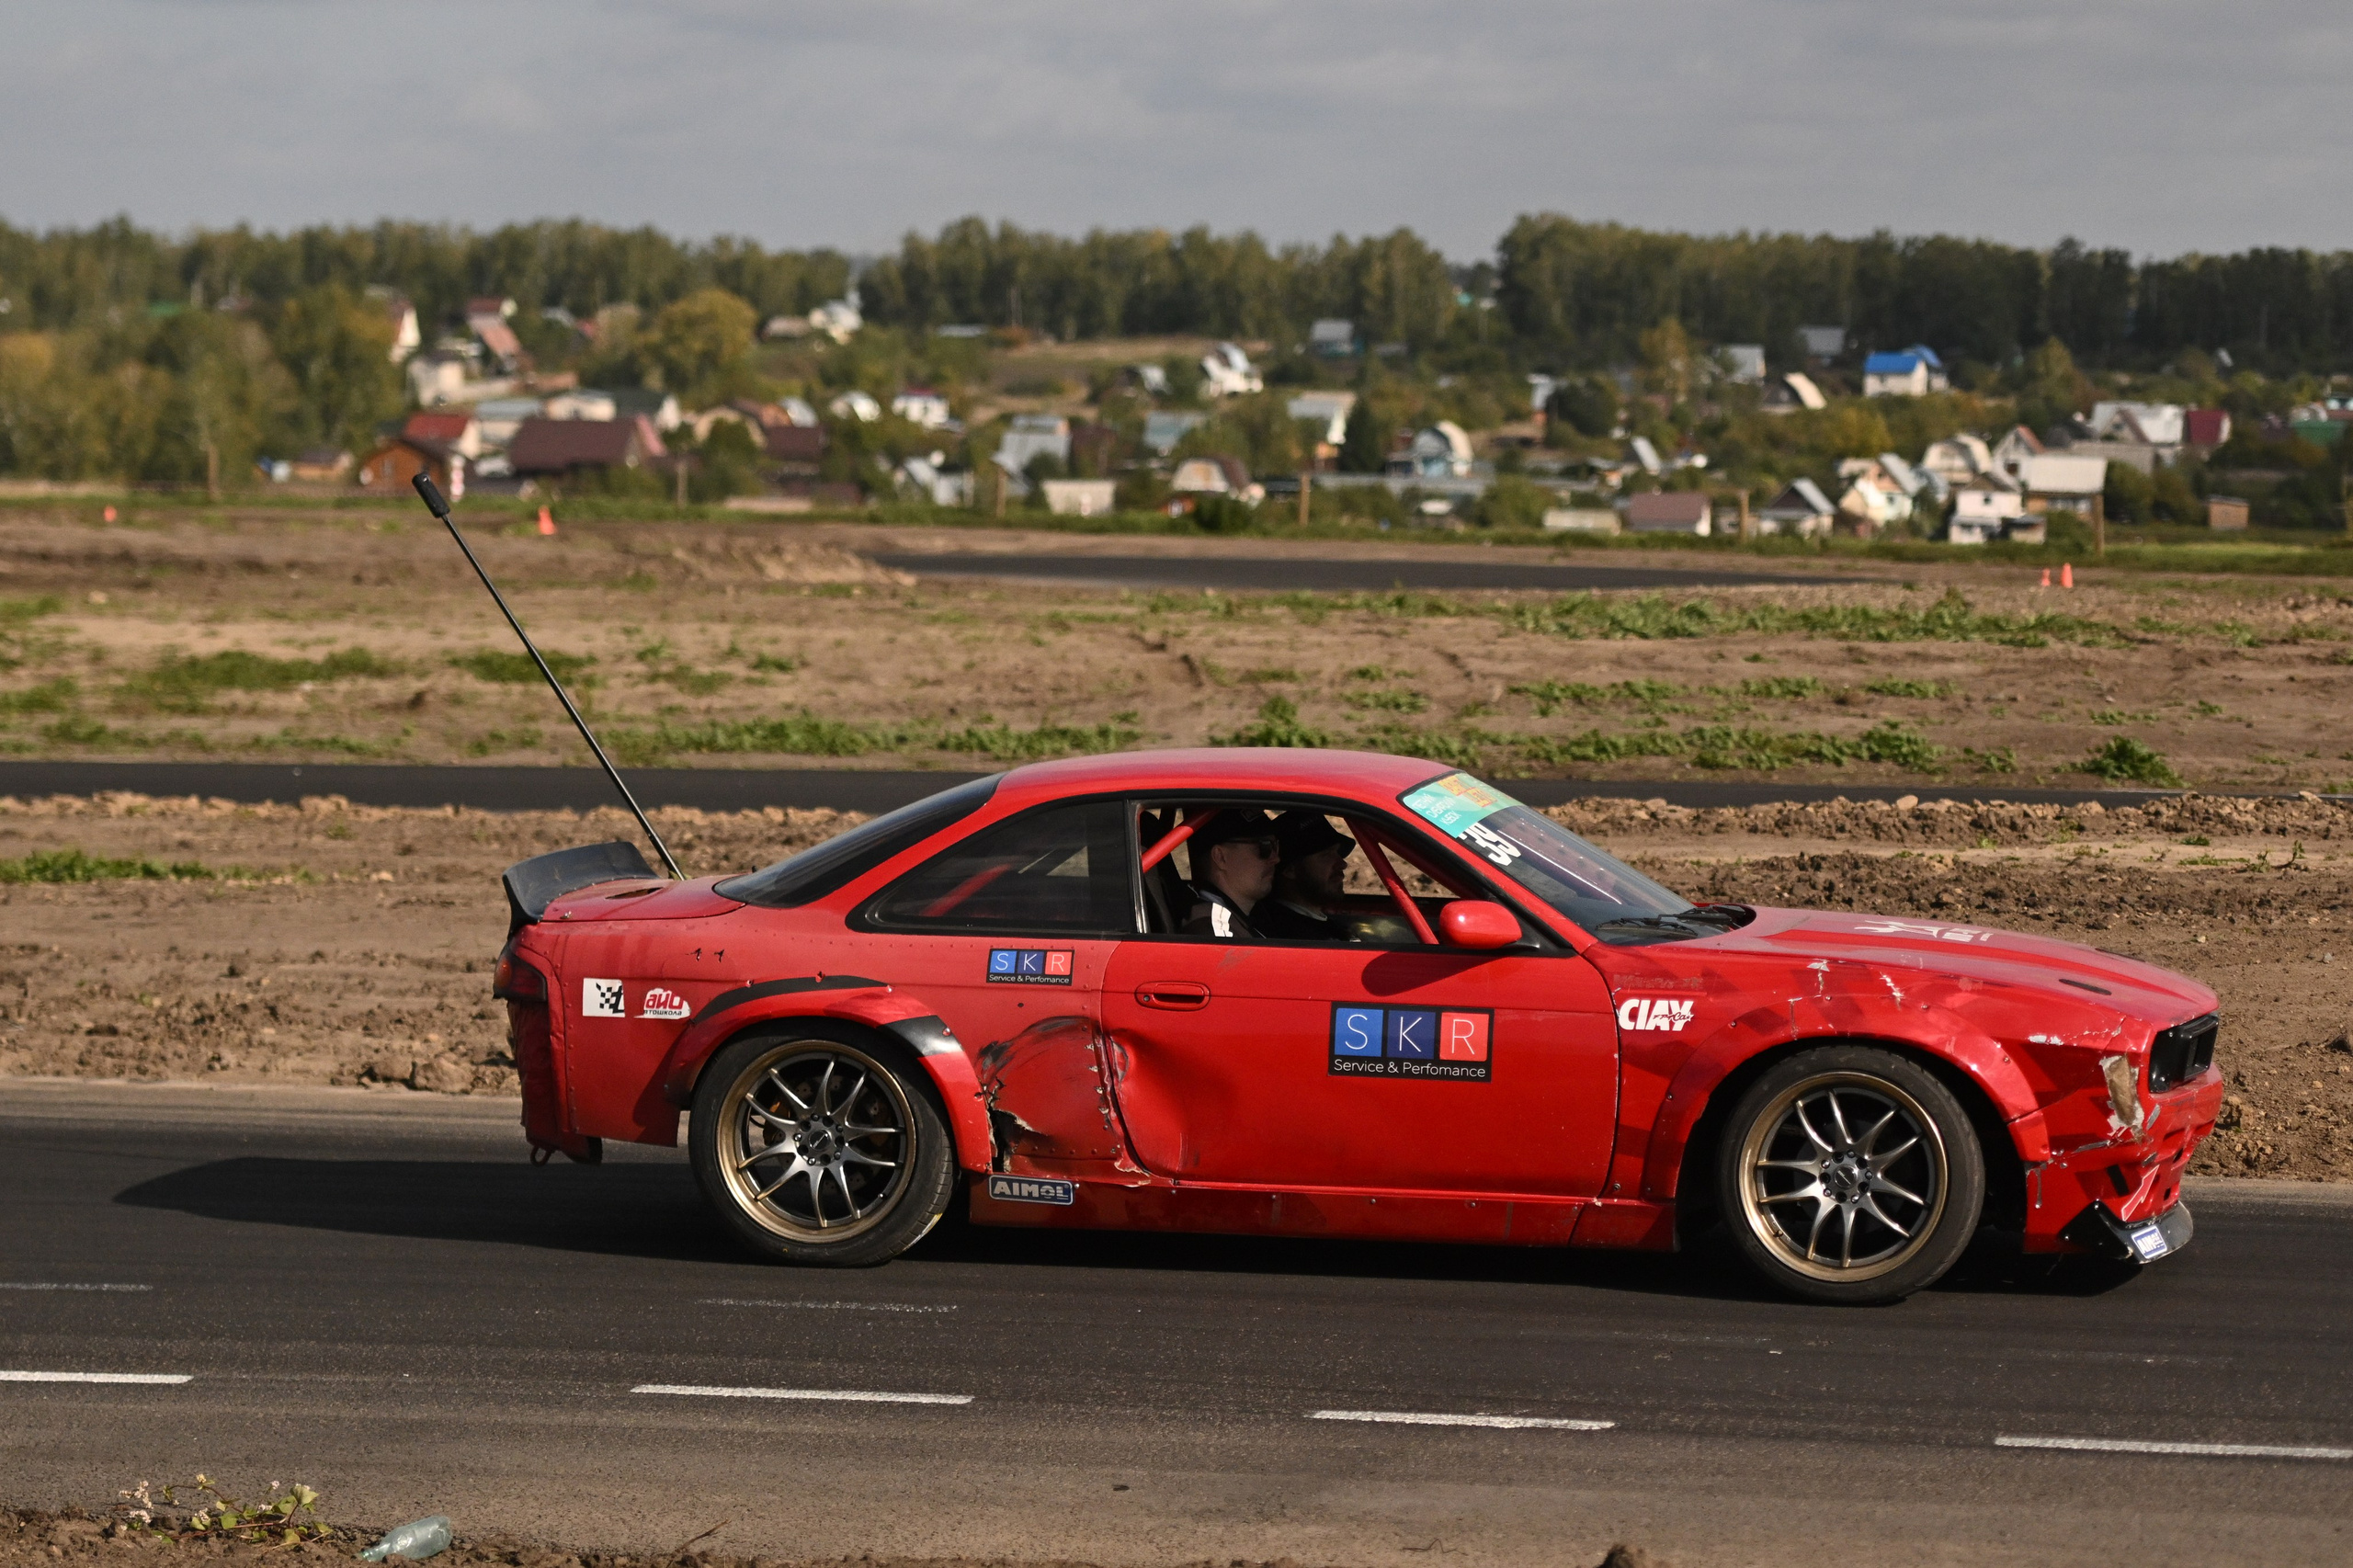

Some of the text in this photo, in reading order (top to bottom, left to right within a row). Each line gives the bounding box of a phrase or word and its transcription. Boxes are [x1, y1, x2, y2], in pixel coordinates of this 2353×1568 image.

[995, 952, 1064, 972] SKR
[989, 974, 1016, 983] Service
[1025, 975, 1069, 984] Perfomance
[1345, 1014, 1475, 1055] SKR
[1334, 1059, 1486, 1078] Service & Perfomance
[993, 1180, 1068, 1199] AIMOL
